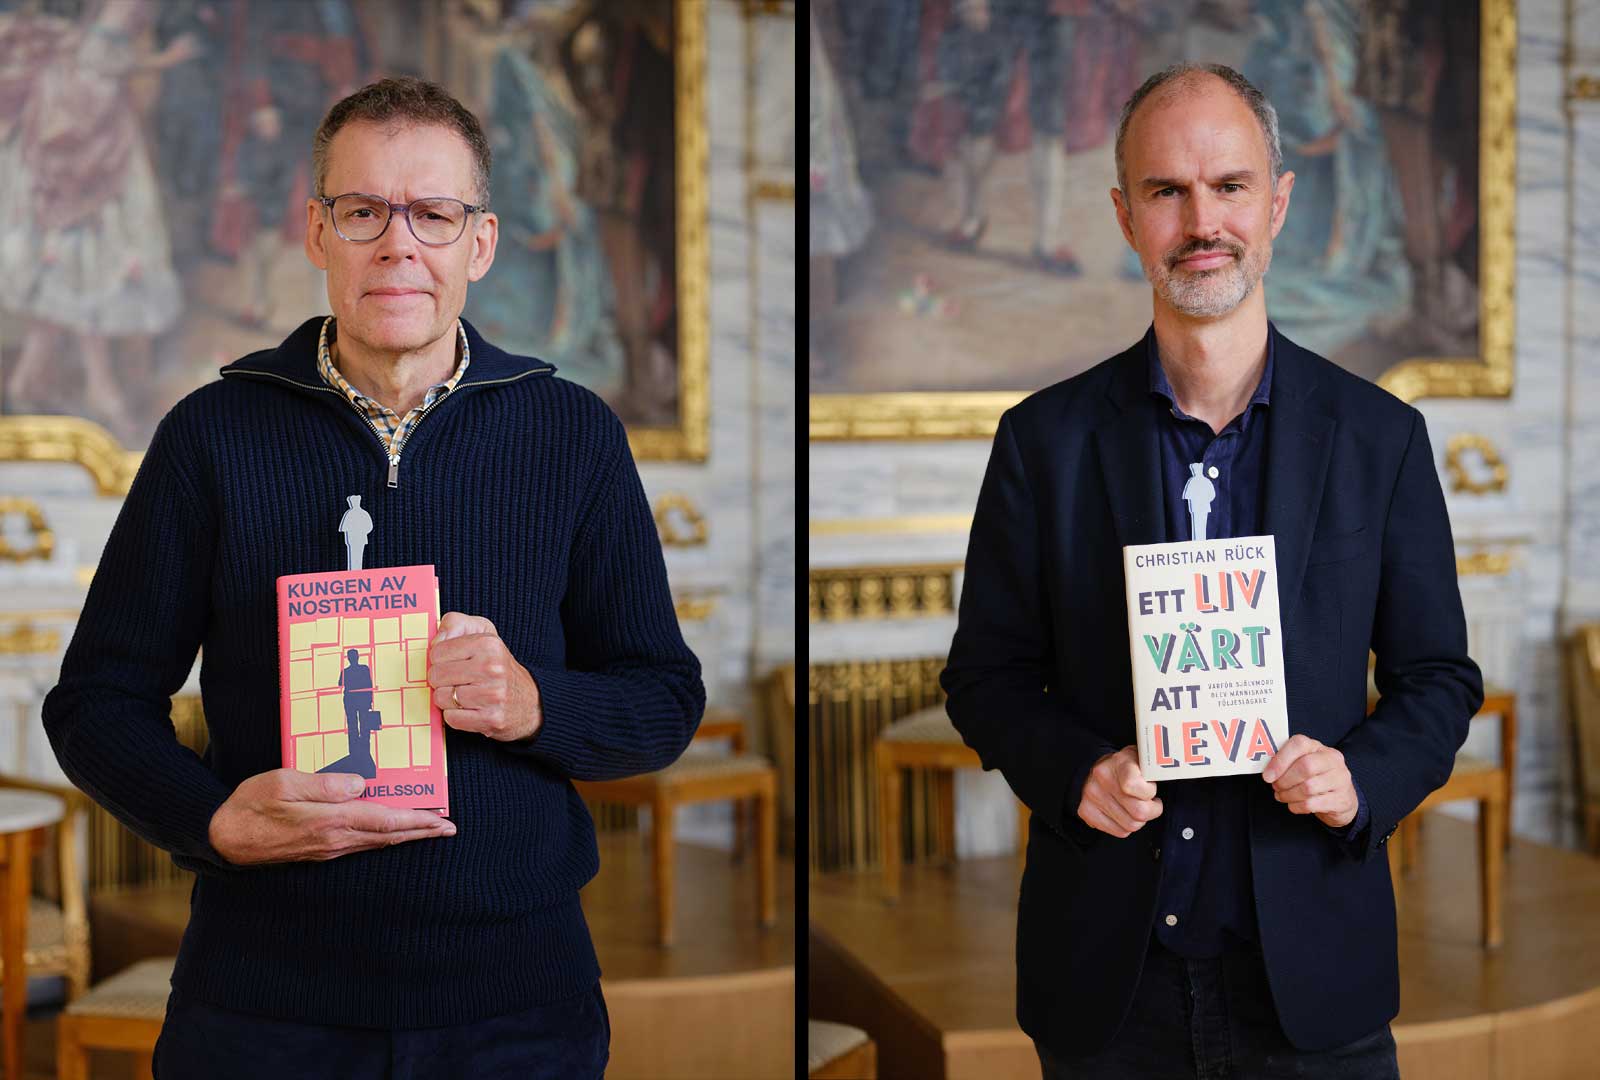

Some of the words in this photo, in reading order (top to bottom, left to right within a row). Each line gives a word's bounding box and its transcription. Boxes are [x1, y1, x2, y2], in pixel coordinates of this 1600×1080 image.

[1135, 549, 1216, 568] CHRISTIAN
[1225, 544, 1265, 561] RÜCK
[287, 578, 371, 599] KUNGEN
[380, 575, 407, 592] AV
[1138, 588, 1186, 616] ETT
[1194, 568, 1267, 614] LIV
[288, 593, 417, 617] NOSTRATIEN
[1143, 621, 1272, 675] VÄRT
[1150, 684, 1201, 712] ATT
[1153, 717, 1279, 768] LEVA
